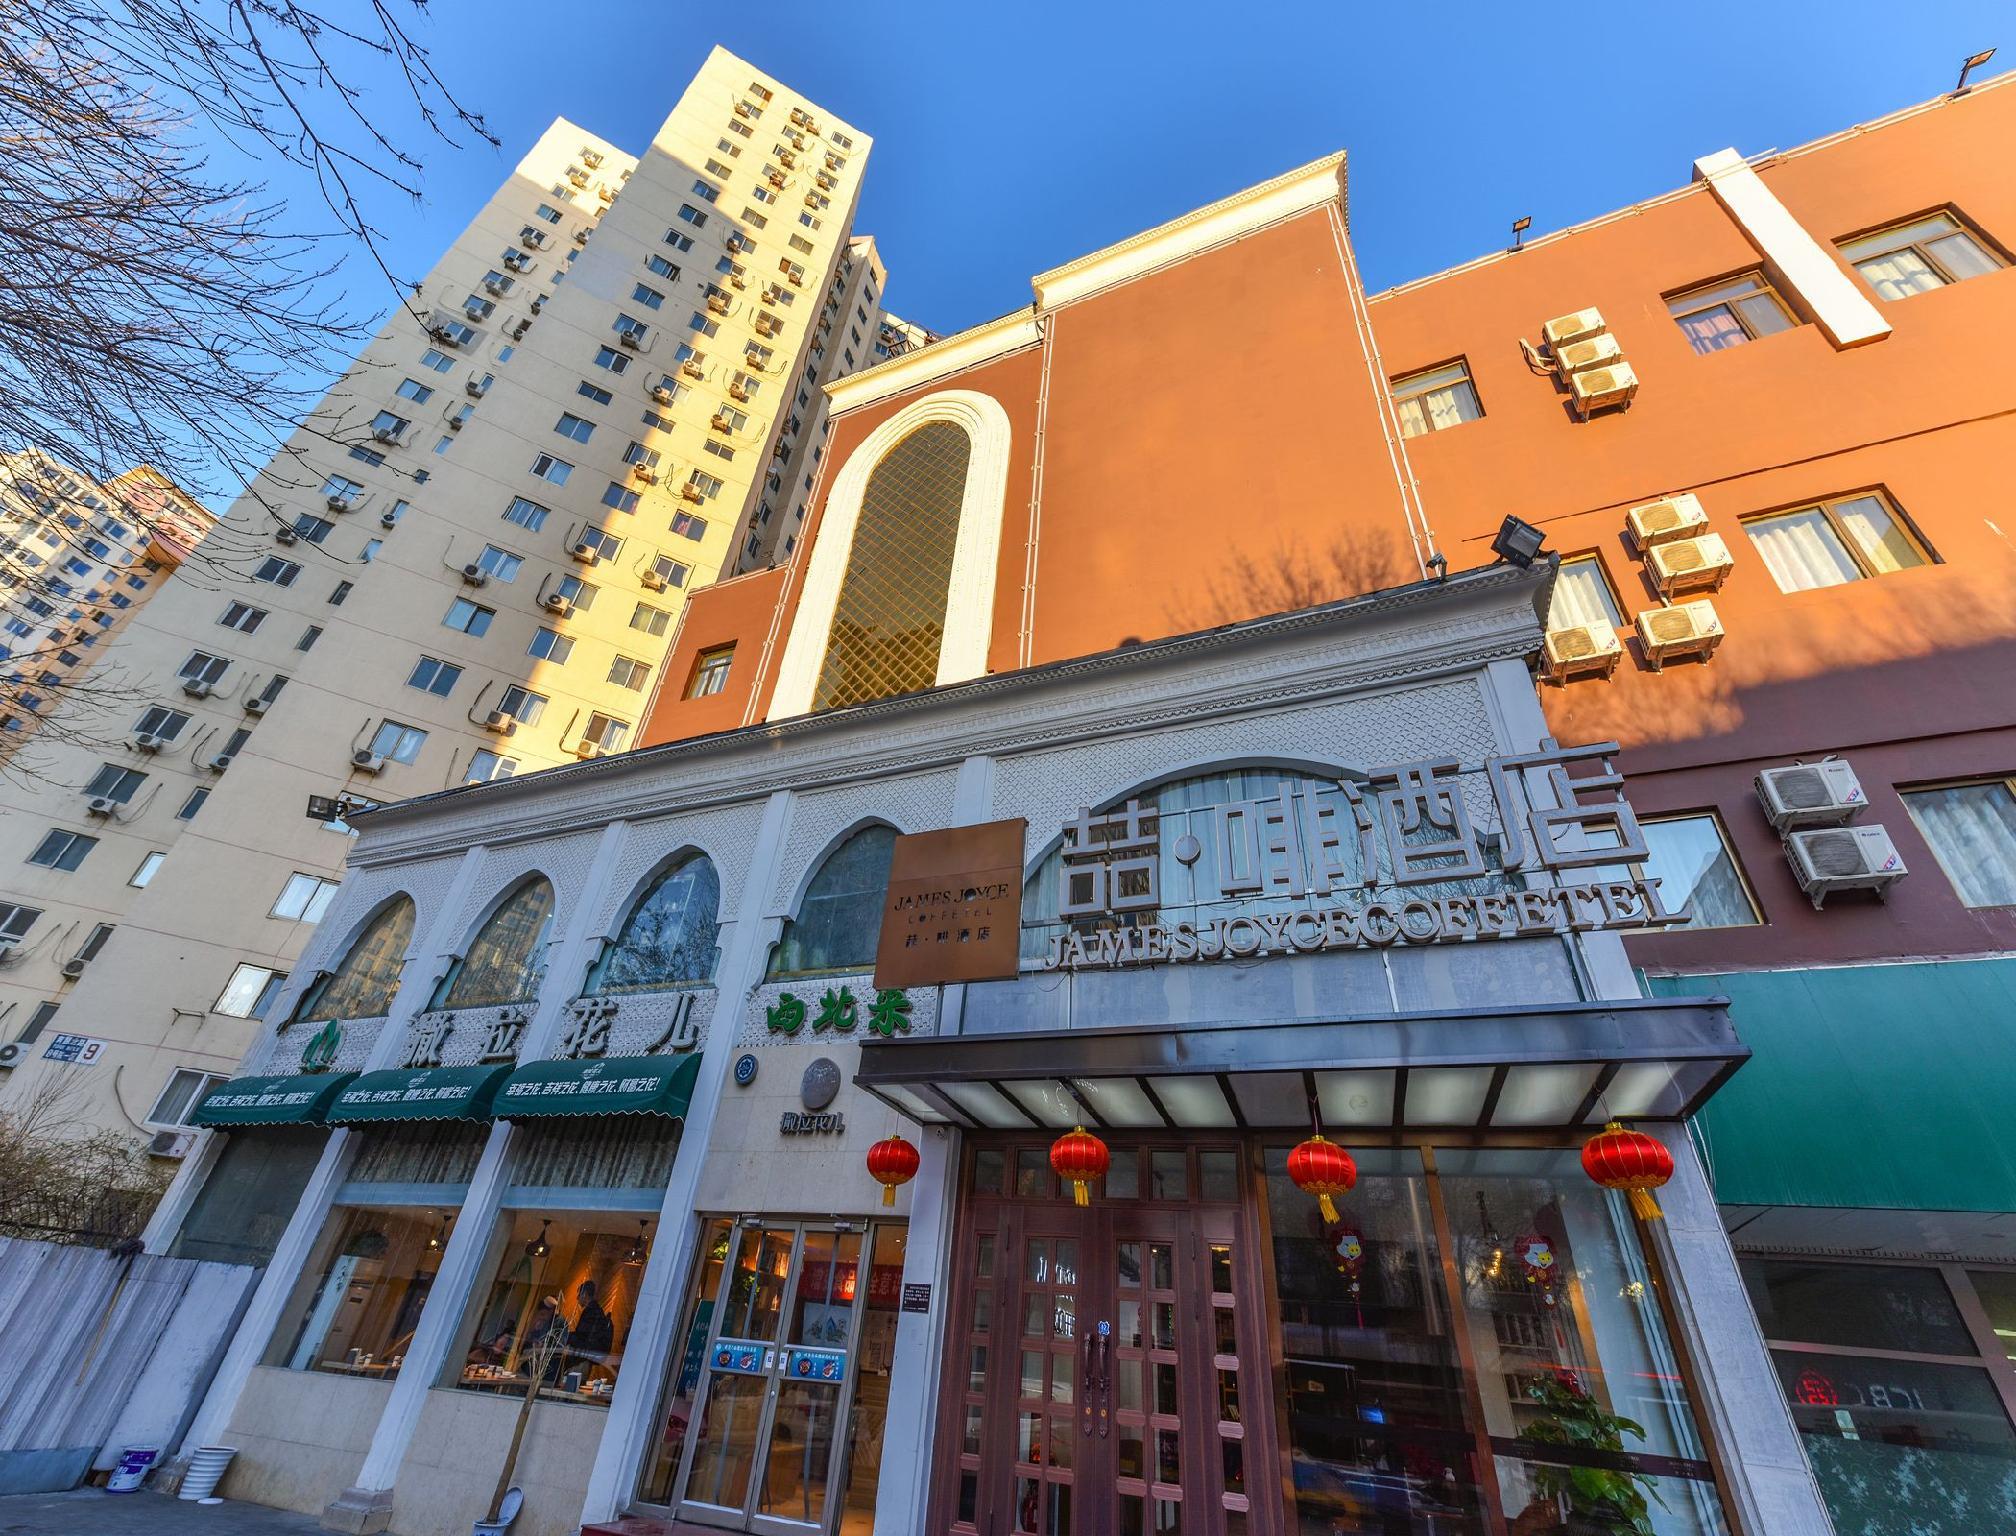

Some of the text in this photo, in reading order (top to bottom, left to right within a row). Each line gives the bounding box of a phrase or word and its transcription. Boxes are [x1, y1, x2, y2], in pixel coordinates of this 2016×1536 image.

[894, 883, 1010, 912] JAMES JOYCE
[83, 1043, 100, 1060] 9
